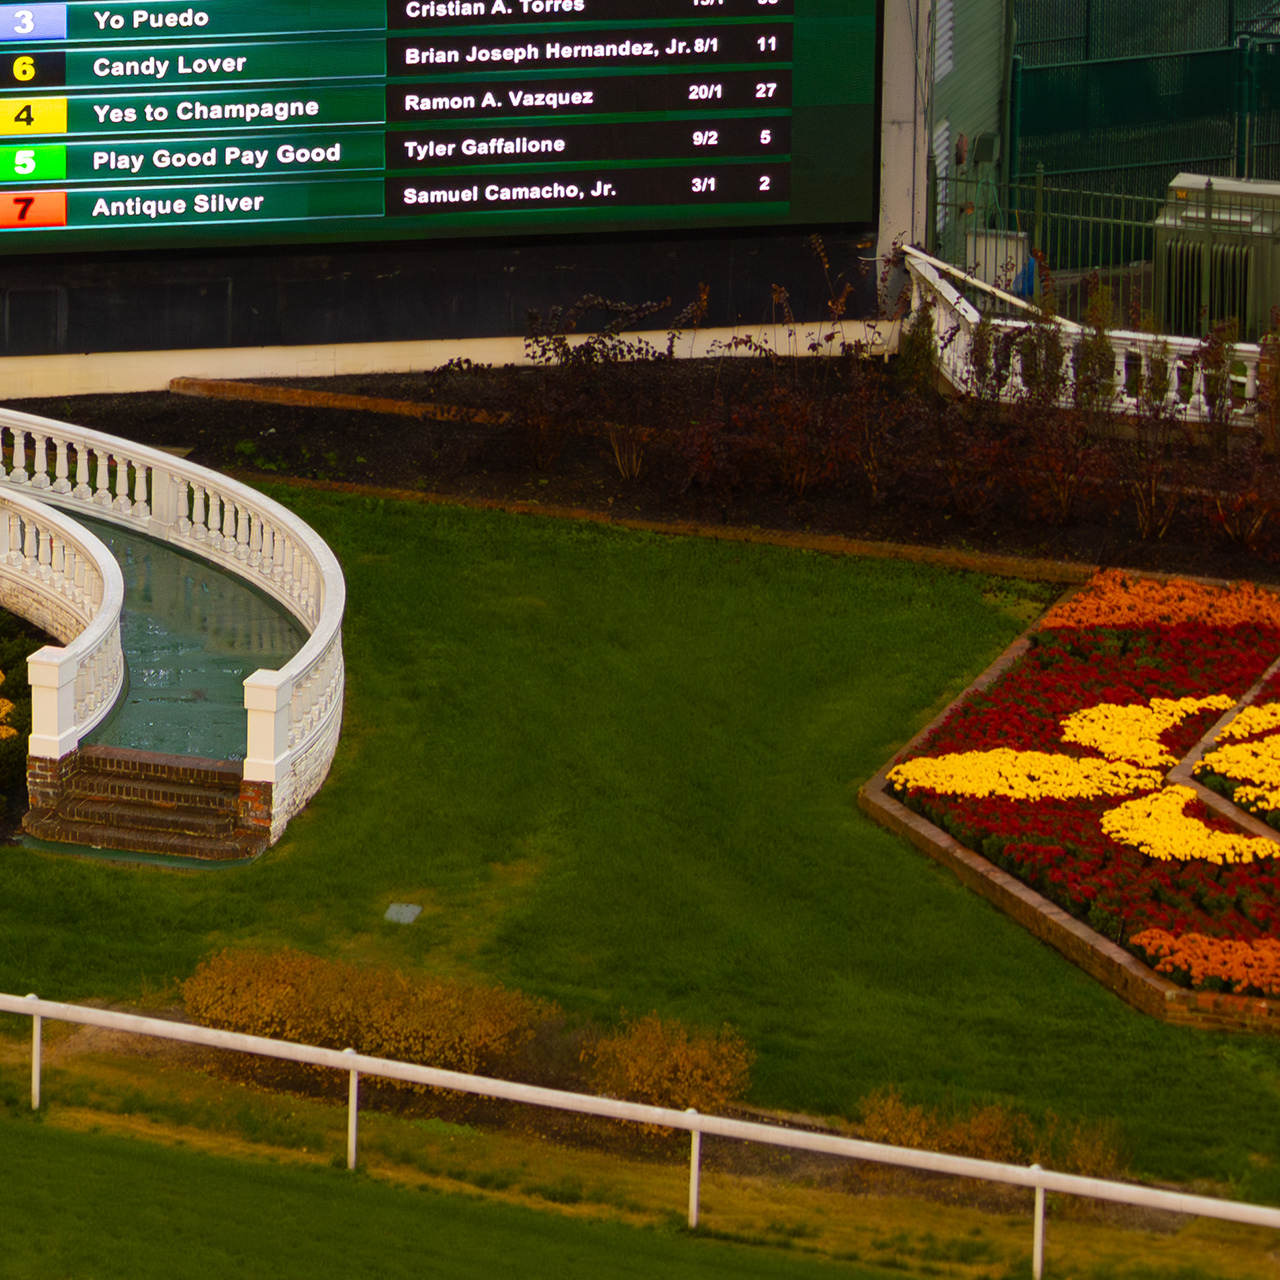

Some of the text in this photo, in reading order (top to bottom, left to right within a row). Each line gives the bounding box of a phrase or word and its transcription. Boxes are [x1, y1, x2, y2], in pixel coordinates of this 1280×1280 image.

[14, 10, 35, 34] 3
[93, 10, 125, 30] Yo
[133, 8, 209, 29] Puedo
[405, 0, 485, 18] Cristian
[13, 56, 35, 81] 6
[93, 56, 170, 79] Candy
[177, 55, 247, 74] Lover
[405, 47, 460, 65] Brian
[465, 43, 539, 64] Joseph
[545, 40, 659, 59] Hernandez,
[665, 38, 690, 55] Jr.
[693, 37, 718, 53] 8/1
[757, 36, 776, 52] 11
[14, 104, 34, 126] 4
[93, 104, 137, 123] Yes
[144, 104, 169, 122] to
[176, 101, 319, 124] Champagne
[405, 94, 475, 111] Ramon
[481, 91, 503, 108] A.
[508, 90, 594, 109] Vazquez
[688, 83, 722, 100] 20/1
[755, 82, 777, 98] 27
[14, 150, 36, 174] 5
[93, 151, 145, 173] Play
[152, 147, 217, 168] Good
[222, 145, 269, 169] Pay
[276, 142, 341, 164] Good
[404, 140, 457, 161] Tyler
[461, 136, 566, 156] Gaffalione
[692, 130, 719, 146] 9/2
[760, 129, 771, 144] 5
[13, 198, 34, 220] 7
[91, 196, 187, 219] Antique
[193, 193, 265, 214] Silver
[403, 185, 478, 204] Samuel
[484, 182, 584, 201] Camacho,
[590, 180, 617, 197] Jr.
[691, 177, 716, 192] 3/1
[759, 175, 771, 191] 2
